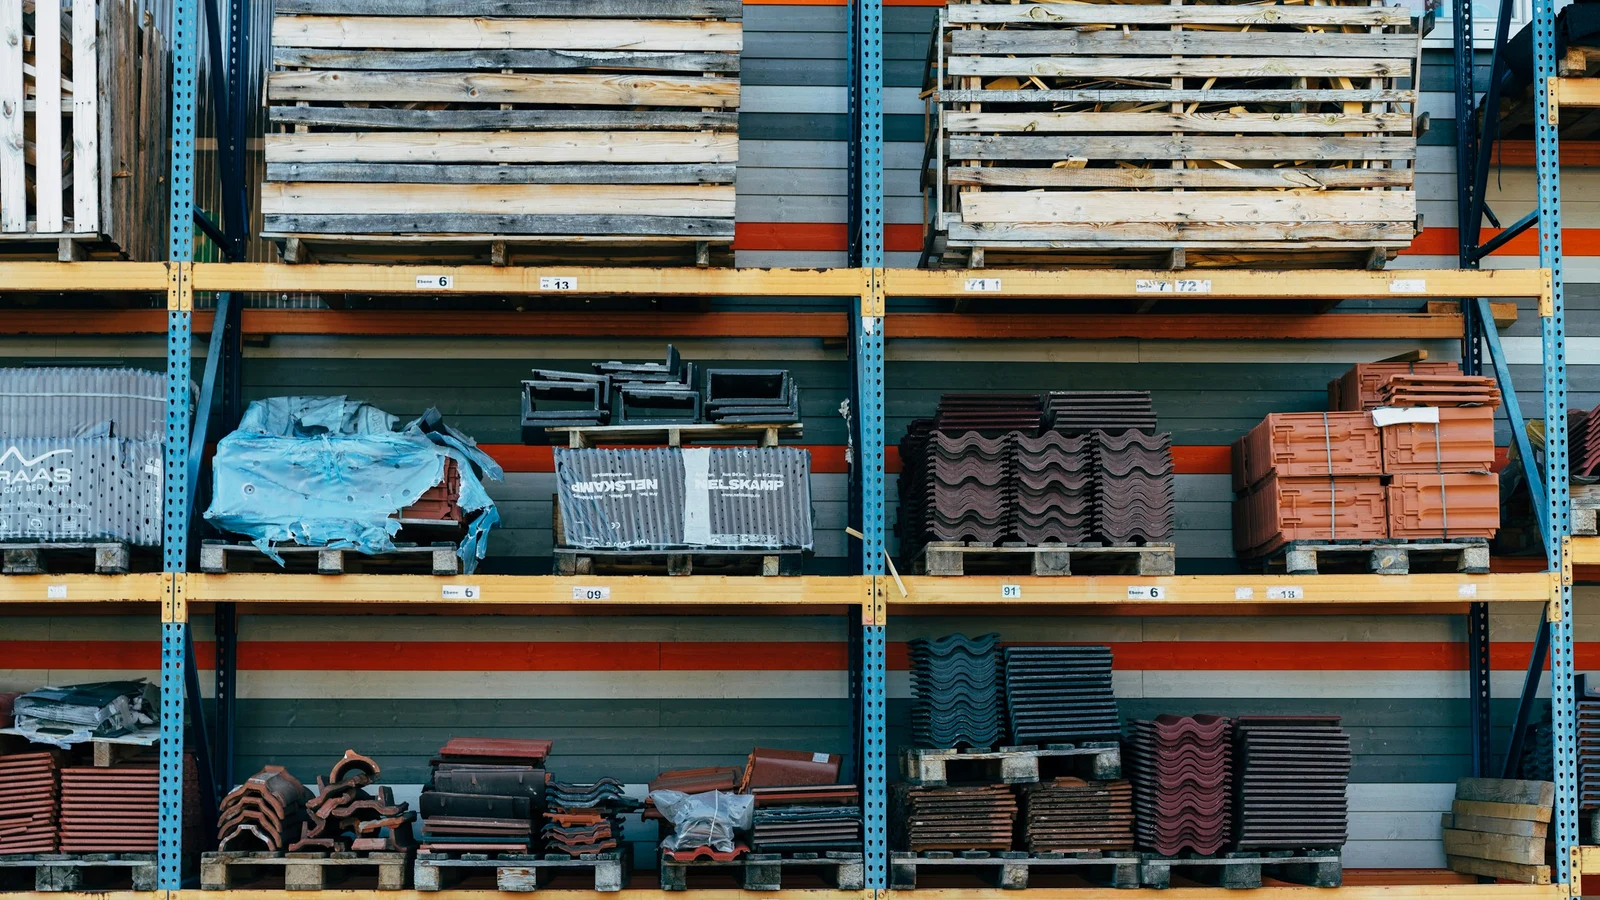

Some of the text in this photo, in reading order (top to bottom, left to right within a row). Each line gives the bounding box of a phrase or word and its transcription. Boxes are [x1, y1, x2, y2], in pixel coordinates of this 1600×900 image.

[439, 276, 448, 287] 6
[554, 281, 569, 290] 13
[1178, 280, 1197, 291] 72
[26, 484, 70, 493] BEDACHT
[571, 479, 658, 493] NELSKAMP
[694, 479, 784, 491] NELSKAMP
[465, 588, 473, 598] 6
[587, 590, 602, 600] 09
[1004, 586, 1016, 596] 91
[1150, 587, 1159, 598] 6
[1280, 590, 1295, 599] 18
